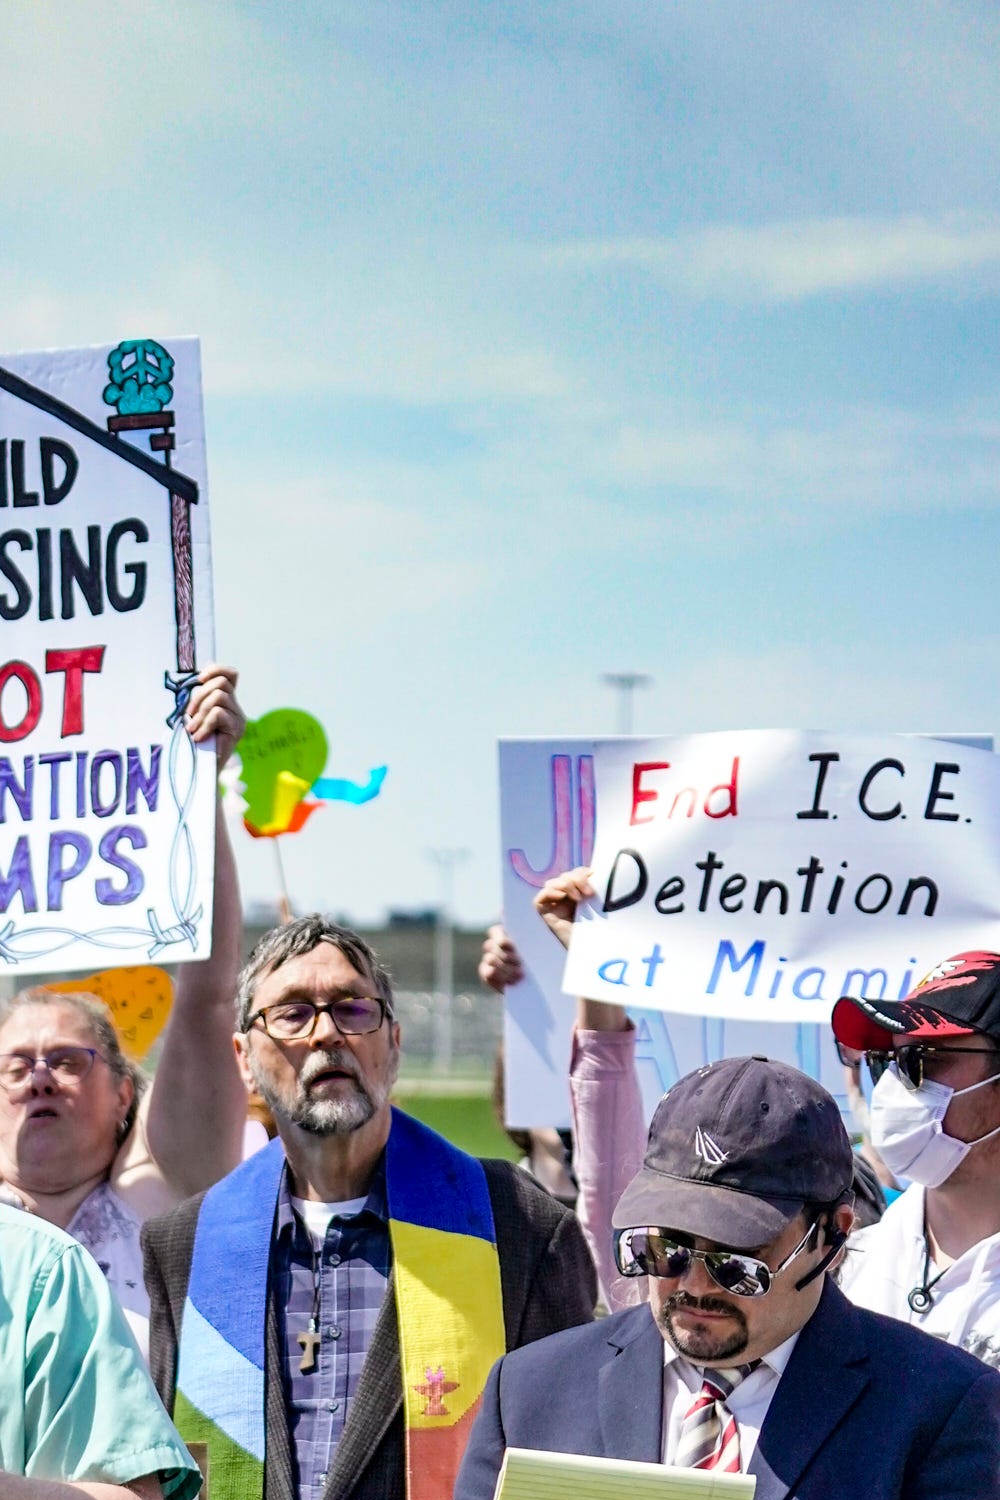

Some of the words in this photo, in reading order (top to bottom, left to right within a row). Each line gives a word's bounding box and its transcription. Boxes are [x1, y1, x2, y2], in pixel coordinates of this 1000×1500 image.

[629, 755, 741, 828] End
[796, 750, 973, 825] I.C.E.
[601, 846, 940, 918] Detention
[597, 942, 667, 989] at
[705, 938, 918, 1002] Miami
